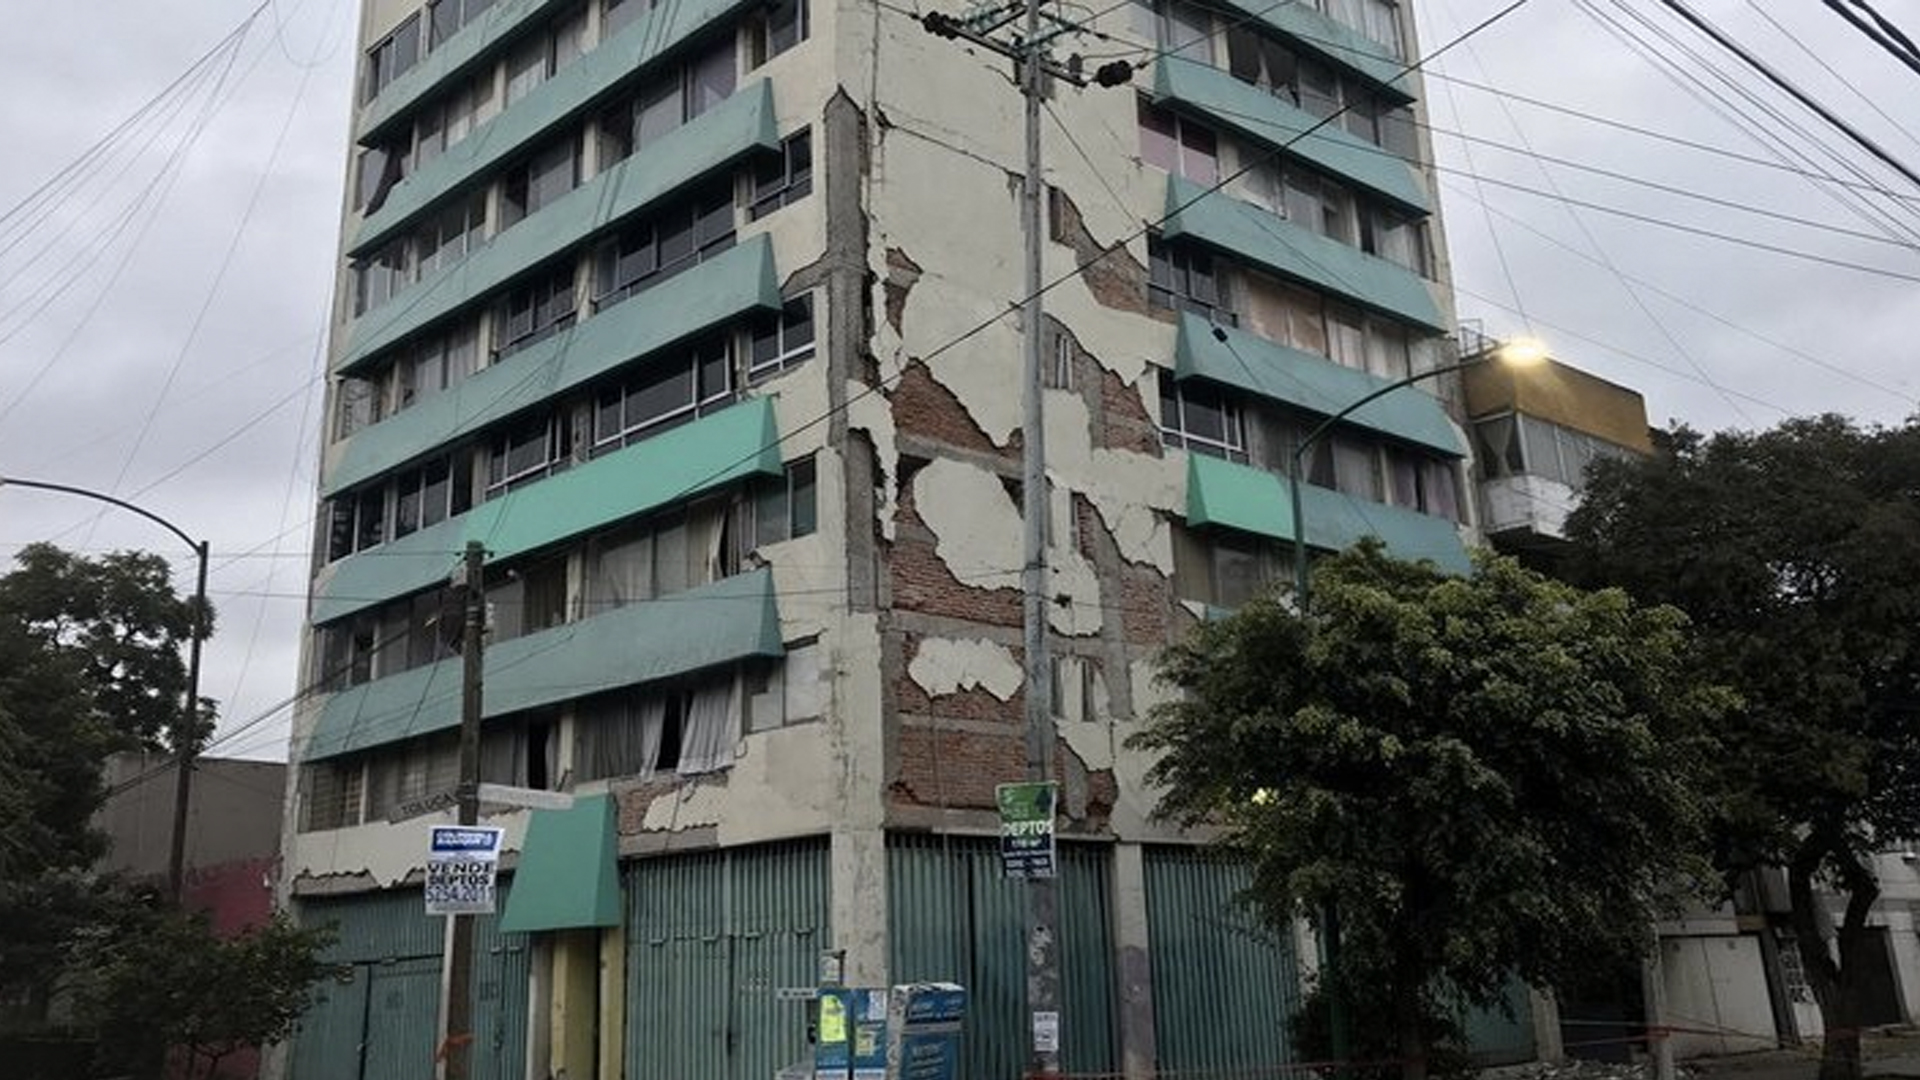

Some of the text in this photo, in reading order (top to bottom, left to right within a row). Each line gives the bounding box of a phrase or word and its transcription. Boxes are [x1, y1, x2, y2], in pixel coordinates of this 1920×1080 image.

[1002, 820, 1054, 836] DEPTOS
[427, 862, 494, 873] VENDE
[428, 874, 490, 886] DEPTOS
